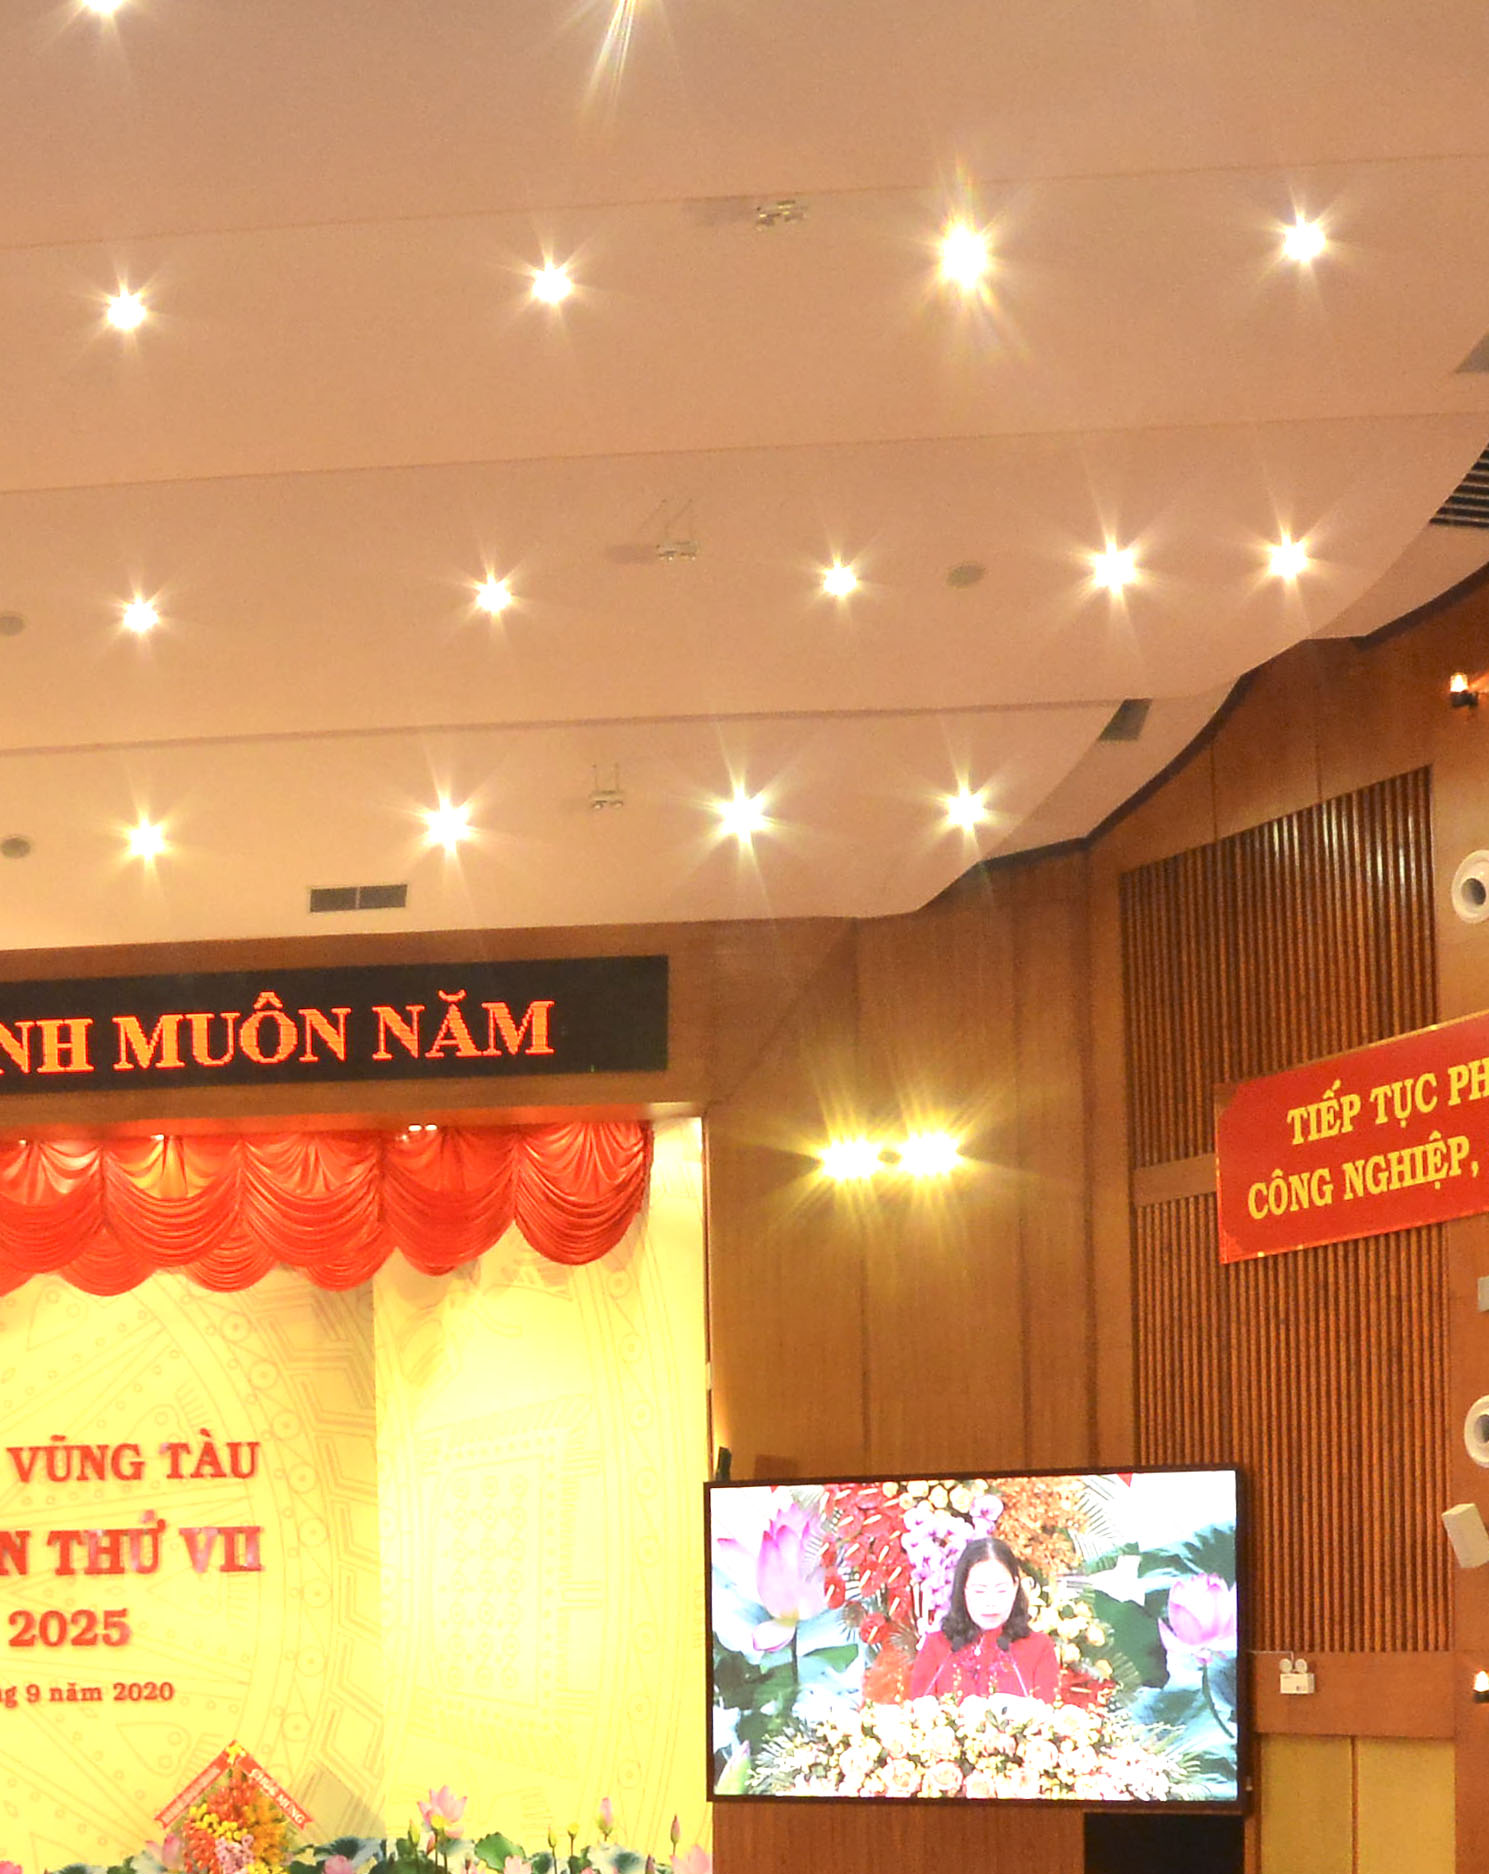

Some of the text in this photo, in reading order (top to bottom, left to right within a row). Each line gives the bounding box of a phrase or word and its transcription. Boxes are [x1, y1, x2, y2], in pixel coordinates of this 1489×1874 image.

[113, 993, 352, 1072] MUÔN
[373, 991, 555, 1061] NĂM
[1289, 1081, 1361, 1145] TIẾP
[1371, 1075, 1438, 1128] TỤC
[1250, 1170, 1334, 1220] CÔNG
[1344, 1132, 1479, 1200] NGHIỆP,
[7, 1432, 146, 1484] VŨNG
[160, 1429, 261, 1480] TÀU
[47, 1511, 168, 1577] THỨ
[180, 1527, 264, 1573] VII
[9, 1609, 132, 1648] 2025
[27, 1685, 42, 1705] 9
[50, 1684, 103, 1703] năm
[114, 1683, 176, 1703] 2020
